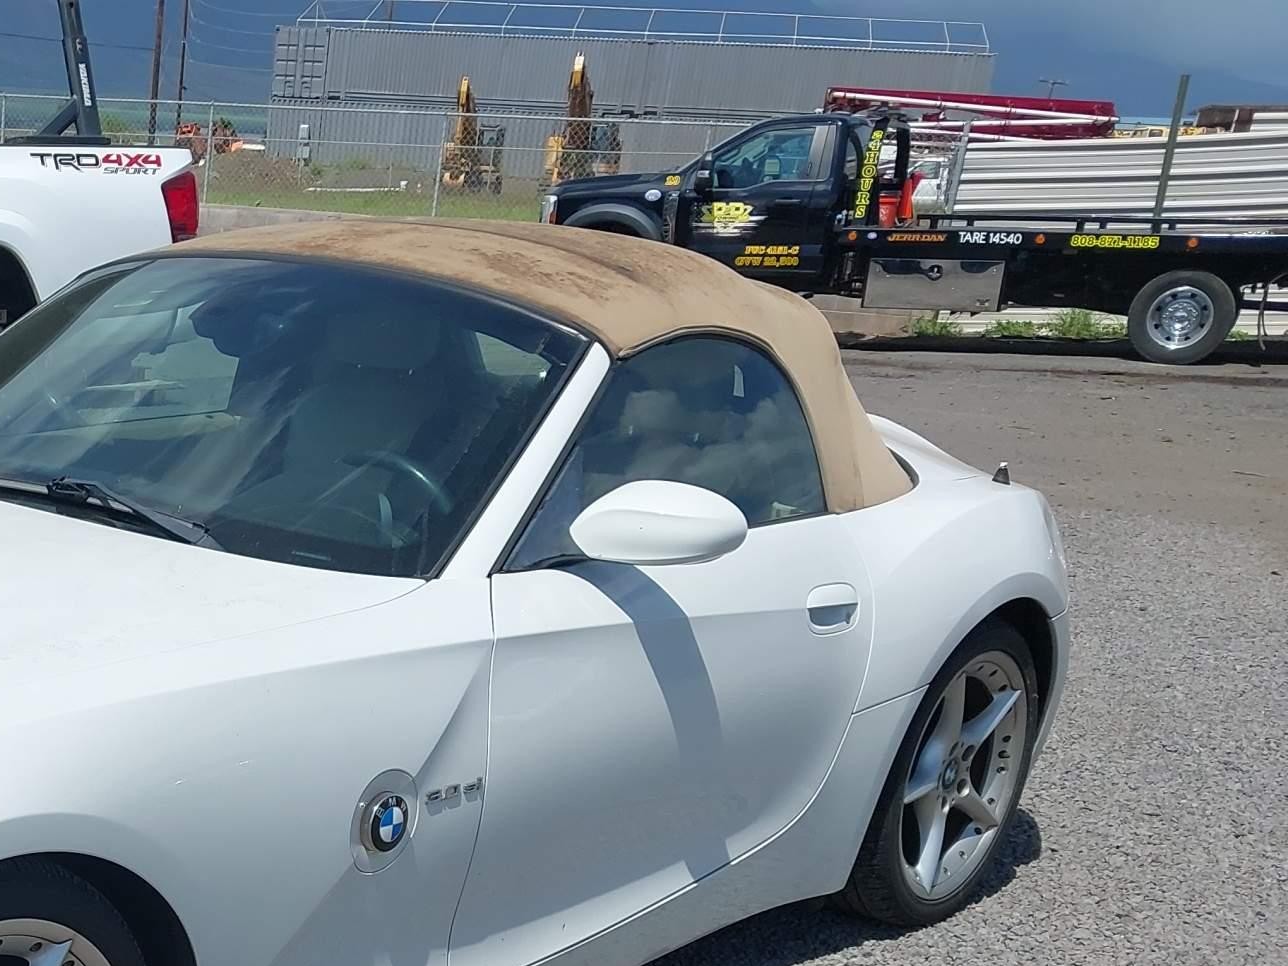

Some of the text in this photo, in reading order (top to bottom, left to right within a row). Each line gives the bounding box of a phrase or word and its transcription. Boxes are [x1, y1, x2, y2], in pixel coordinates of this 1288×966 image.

[30, 153, 102, 172] TRD
[103, 166, 160, 175] SPORT
[855, 151, 878, 218] HOURS
[958, 231, 987, 244] TARE
[989, 233, 1023, 244] 14540
[1071, 234, 1160, 248] 808-871-1185
